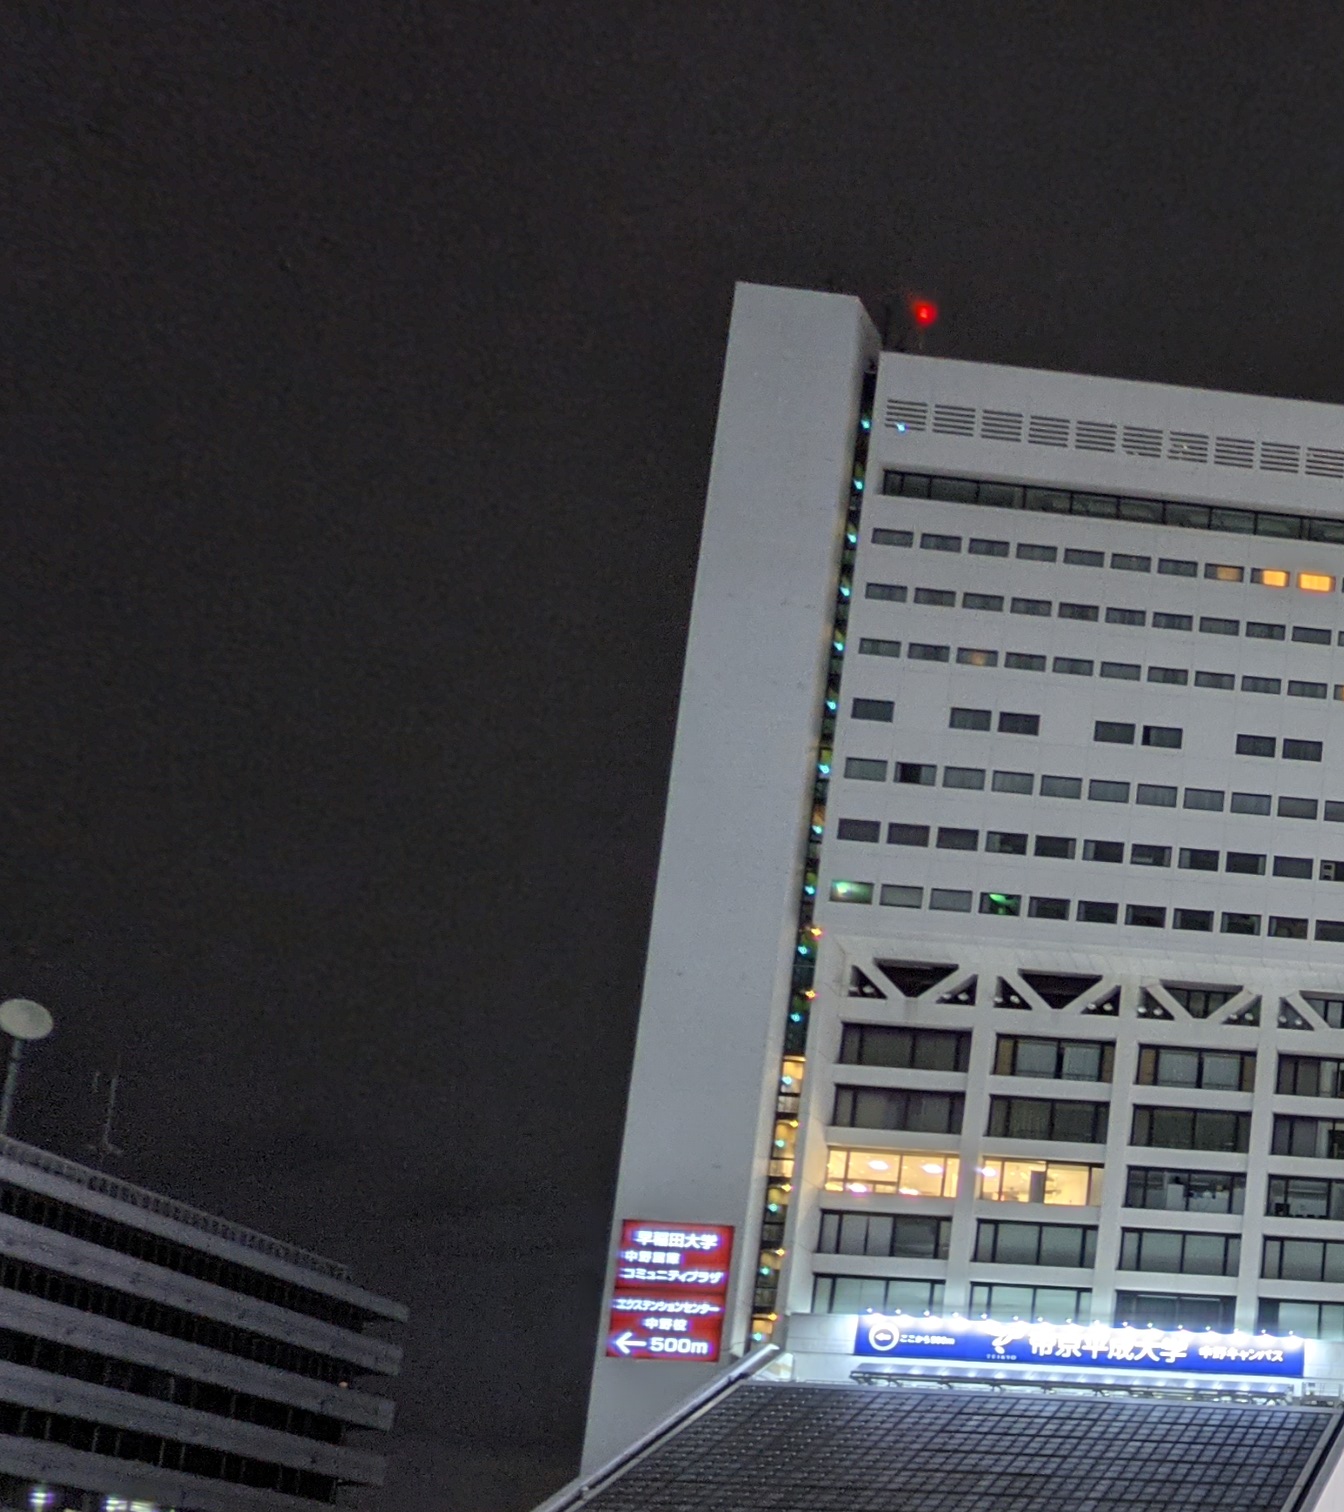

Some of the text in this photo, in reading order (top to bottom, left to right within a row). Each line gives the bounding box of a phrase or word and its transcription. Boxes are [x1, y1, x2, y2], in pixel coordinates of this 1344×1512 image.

[619, 1267, 724, 1284] コミュニティプラザ
[649, 1336, 709, 1355] 500m
[1028, 1331, 1283, 1364] 帝京平成大学 中野キャンパス
